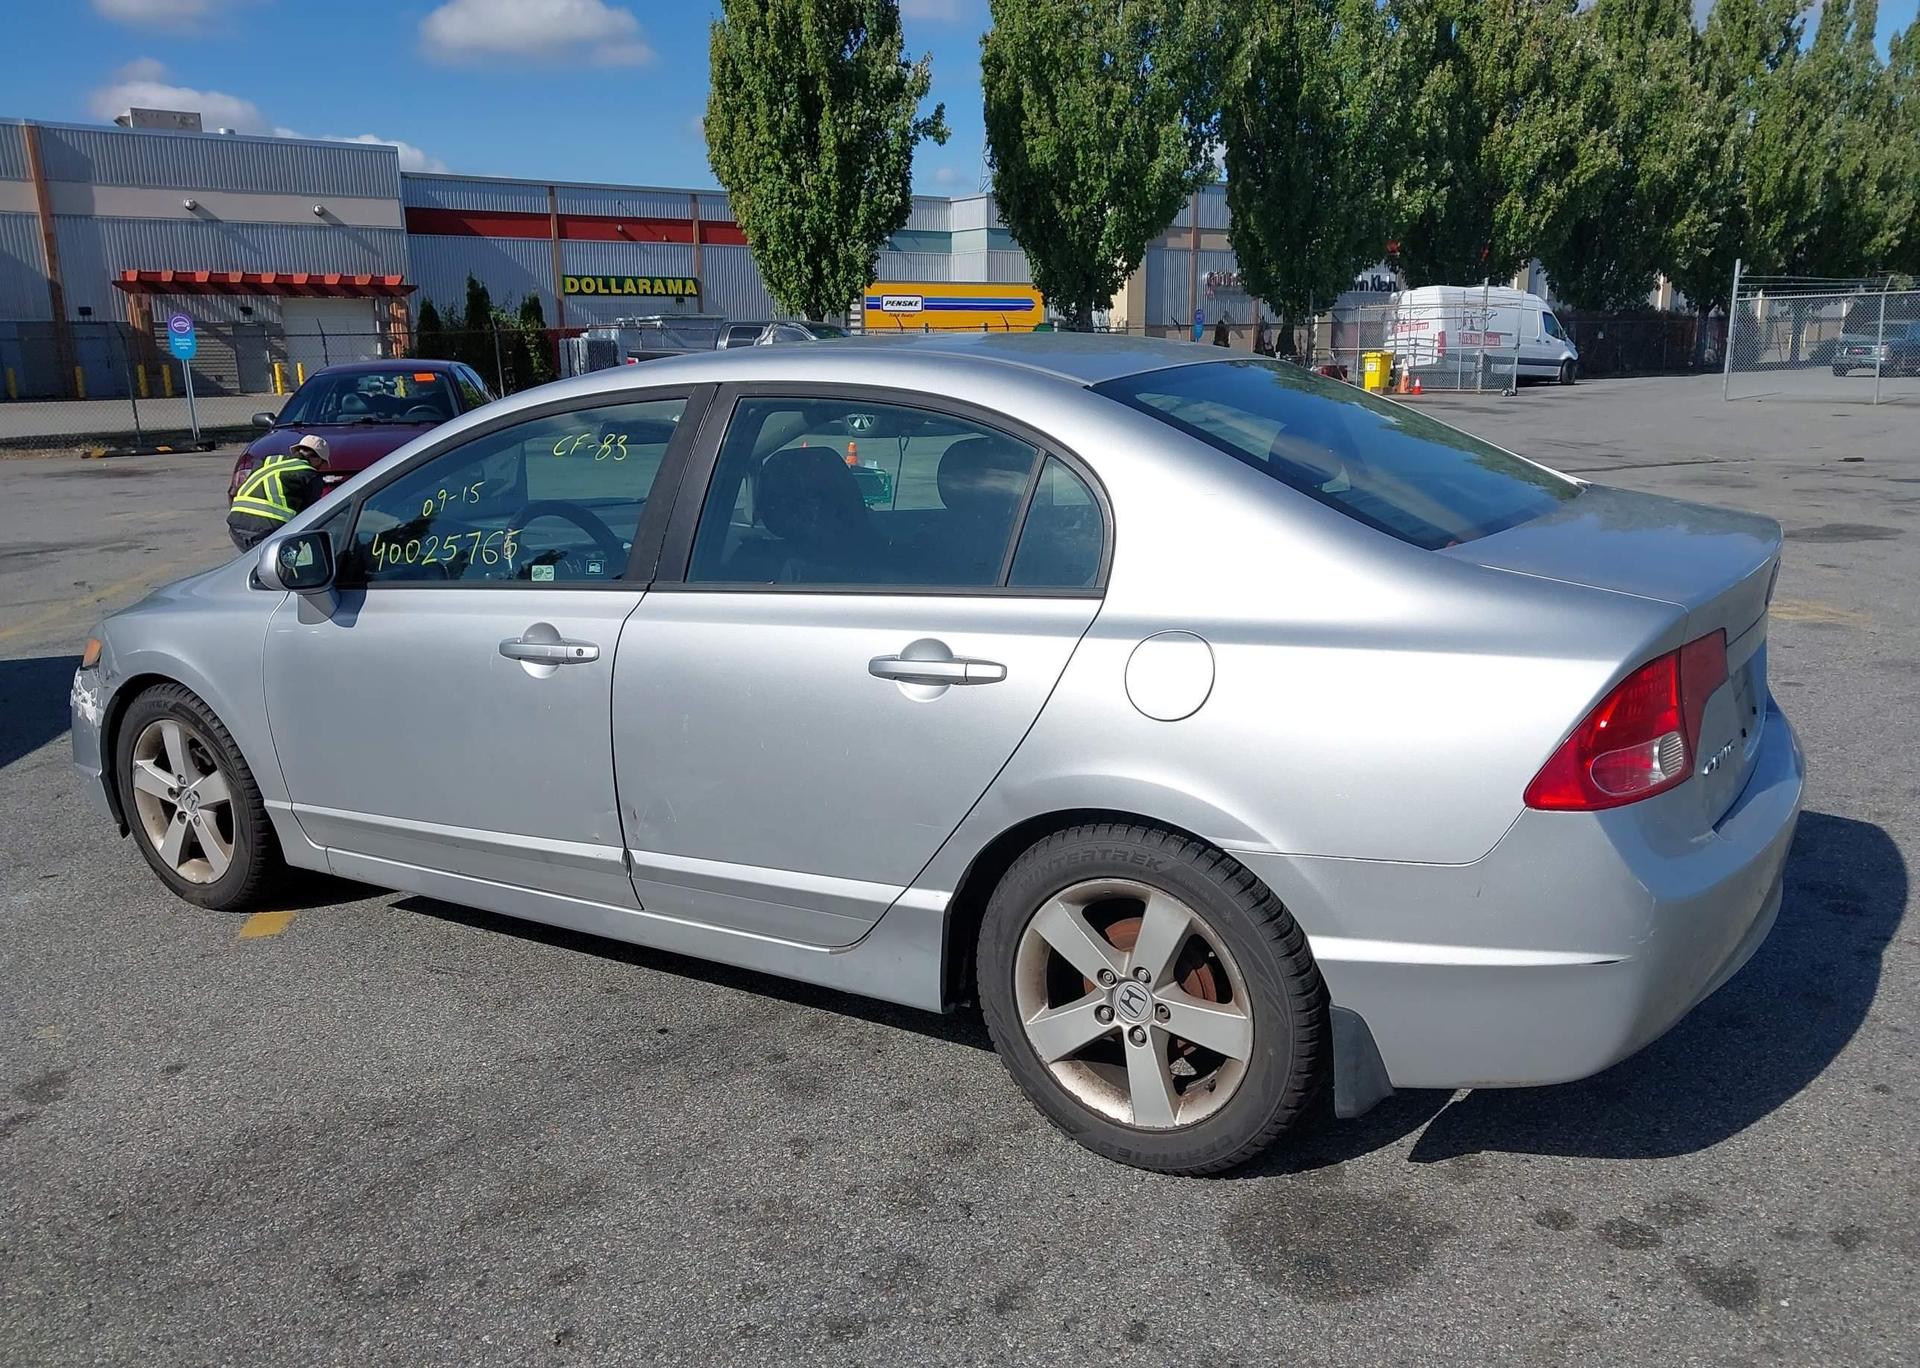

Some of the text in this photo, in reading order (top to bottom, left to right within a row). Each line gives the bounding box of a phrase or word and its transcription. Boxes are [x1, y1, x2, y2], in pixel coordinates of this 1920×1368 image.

[564, 276, 698, 295] DOLLARAMA
[1371, 274, 1396, 292] Klein
[553, 433, 628, 461] CF-83
[422, 480, 486, 517] 09-15
